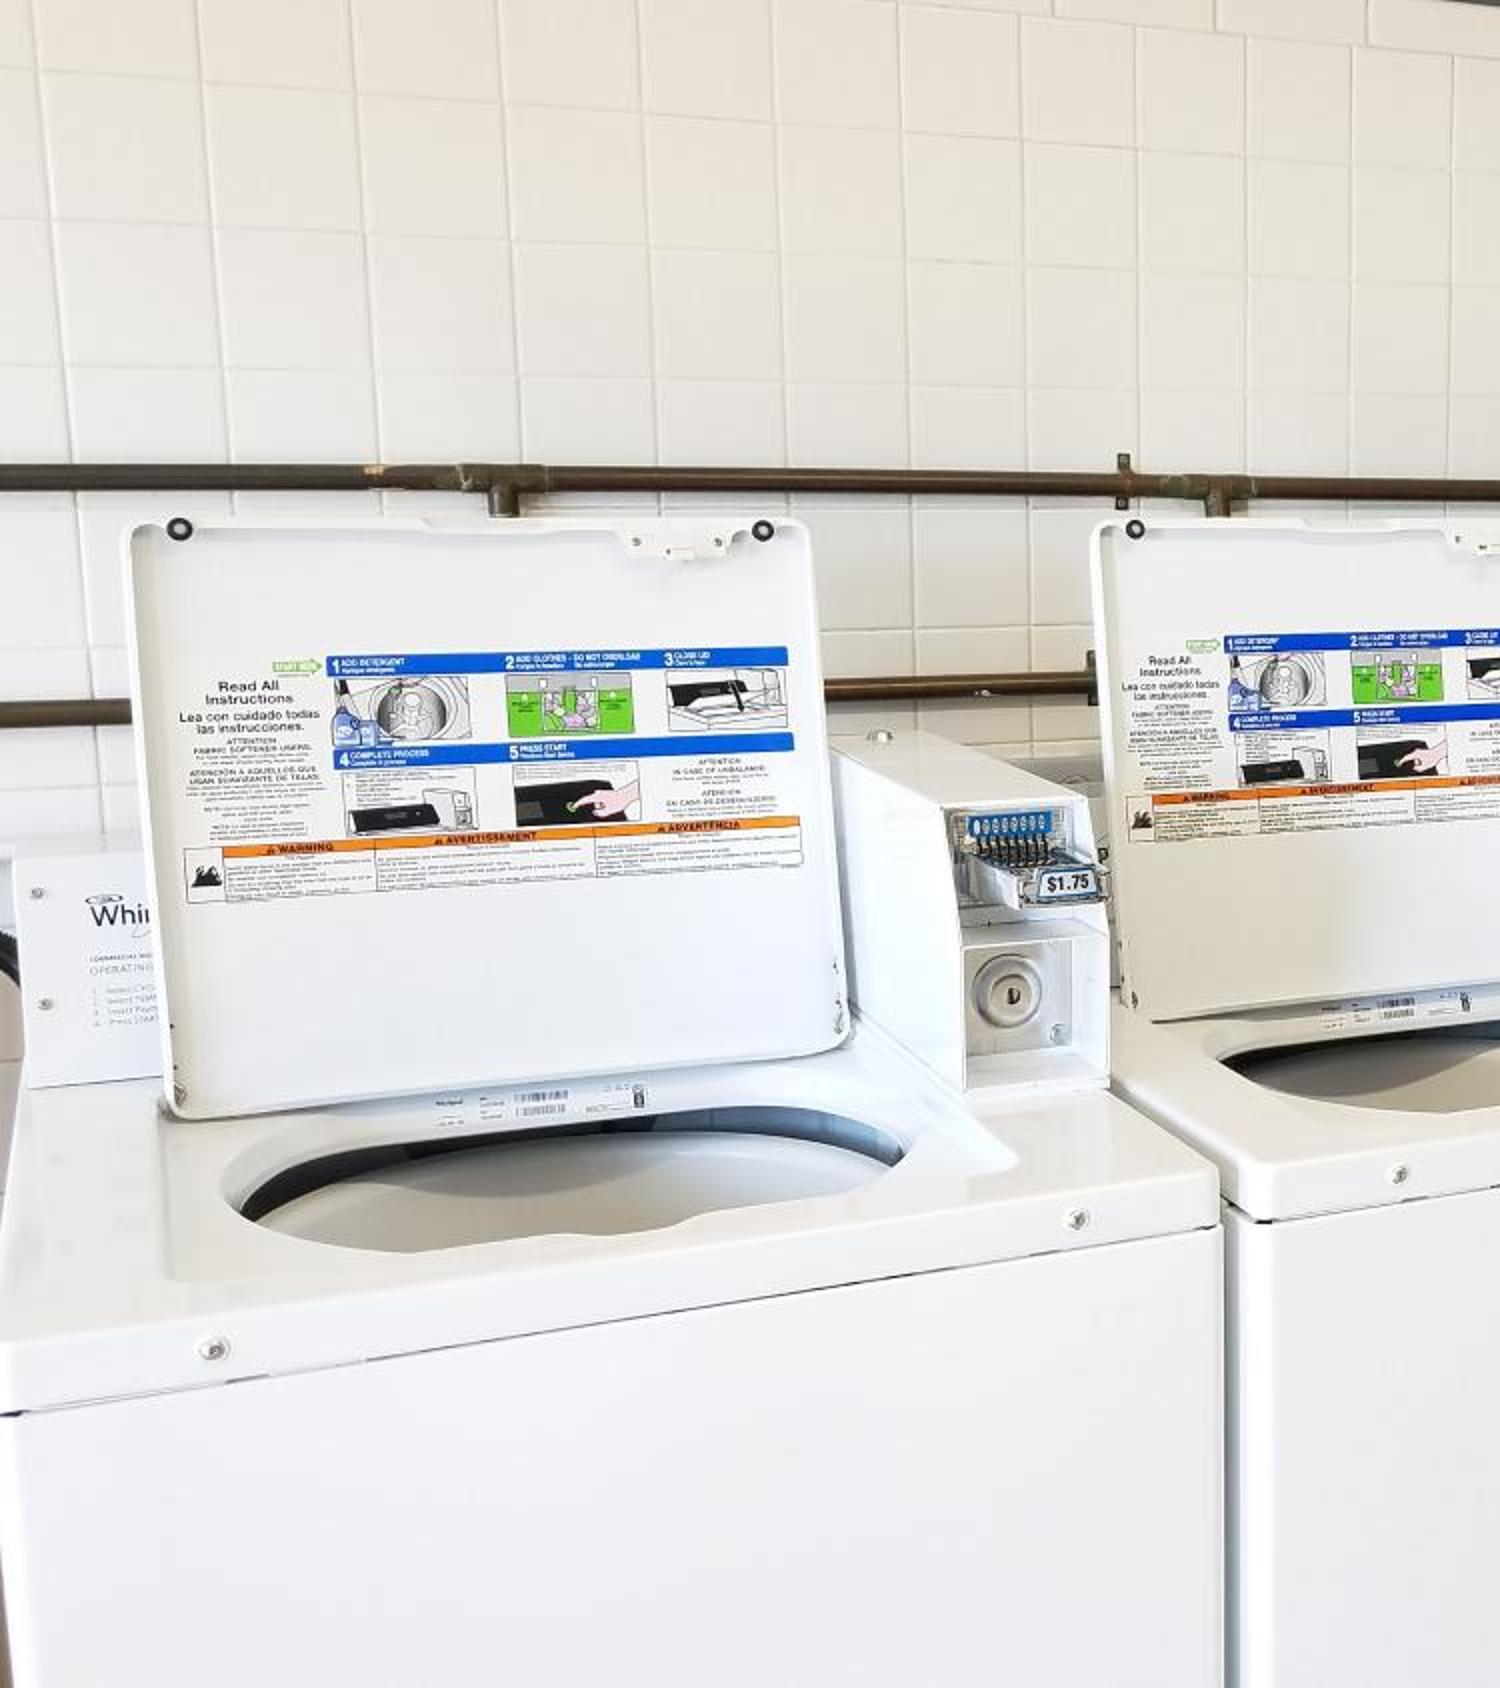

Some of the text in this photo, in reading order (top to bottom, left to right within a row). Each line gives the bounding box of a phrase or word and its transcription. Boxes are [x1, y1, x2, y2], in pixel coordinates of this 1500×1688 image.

[505, 655, 515, 669] 2
[664, 652, 673, 666] 3
[1149, 655, 1176, 665] Read
[332, 659, 340, 674] 1
[1140, 667, 1202, 676] Instructions
[218, 680, 279, 692] Read All
[1121, 682, 1138, 691] Lea
[206, 694, 294, 705] Instructions
[179, 708, 320, 723] Lea con cuidado todas
[1353, 712, 1361, 723] 5
[197, 722, 305, 734] las instrucciones.
[510, 745, 519, 759] 5
[340, 752, 349, 767] 4
[279, 820, 741, 854] WARNING AVERTISSEMENT ADVERTENCIA
[1047, 874, 1090, 893] $1.75
